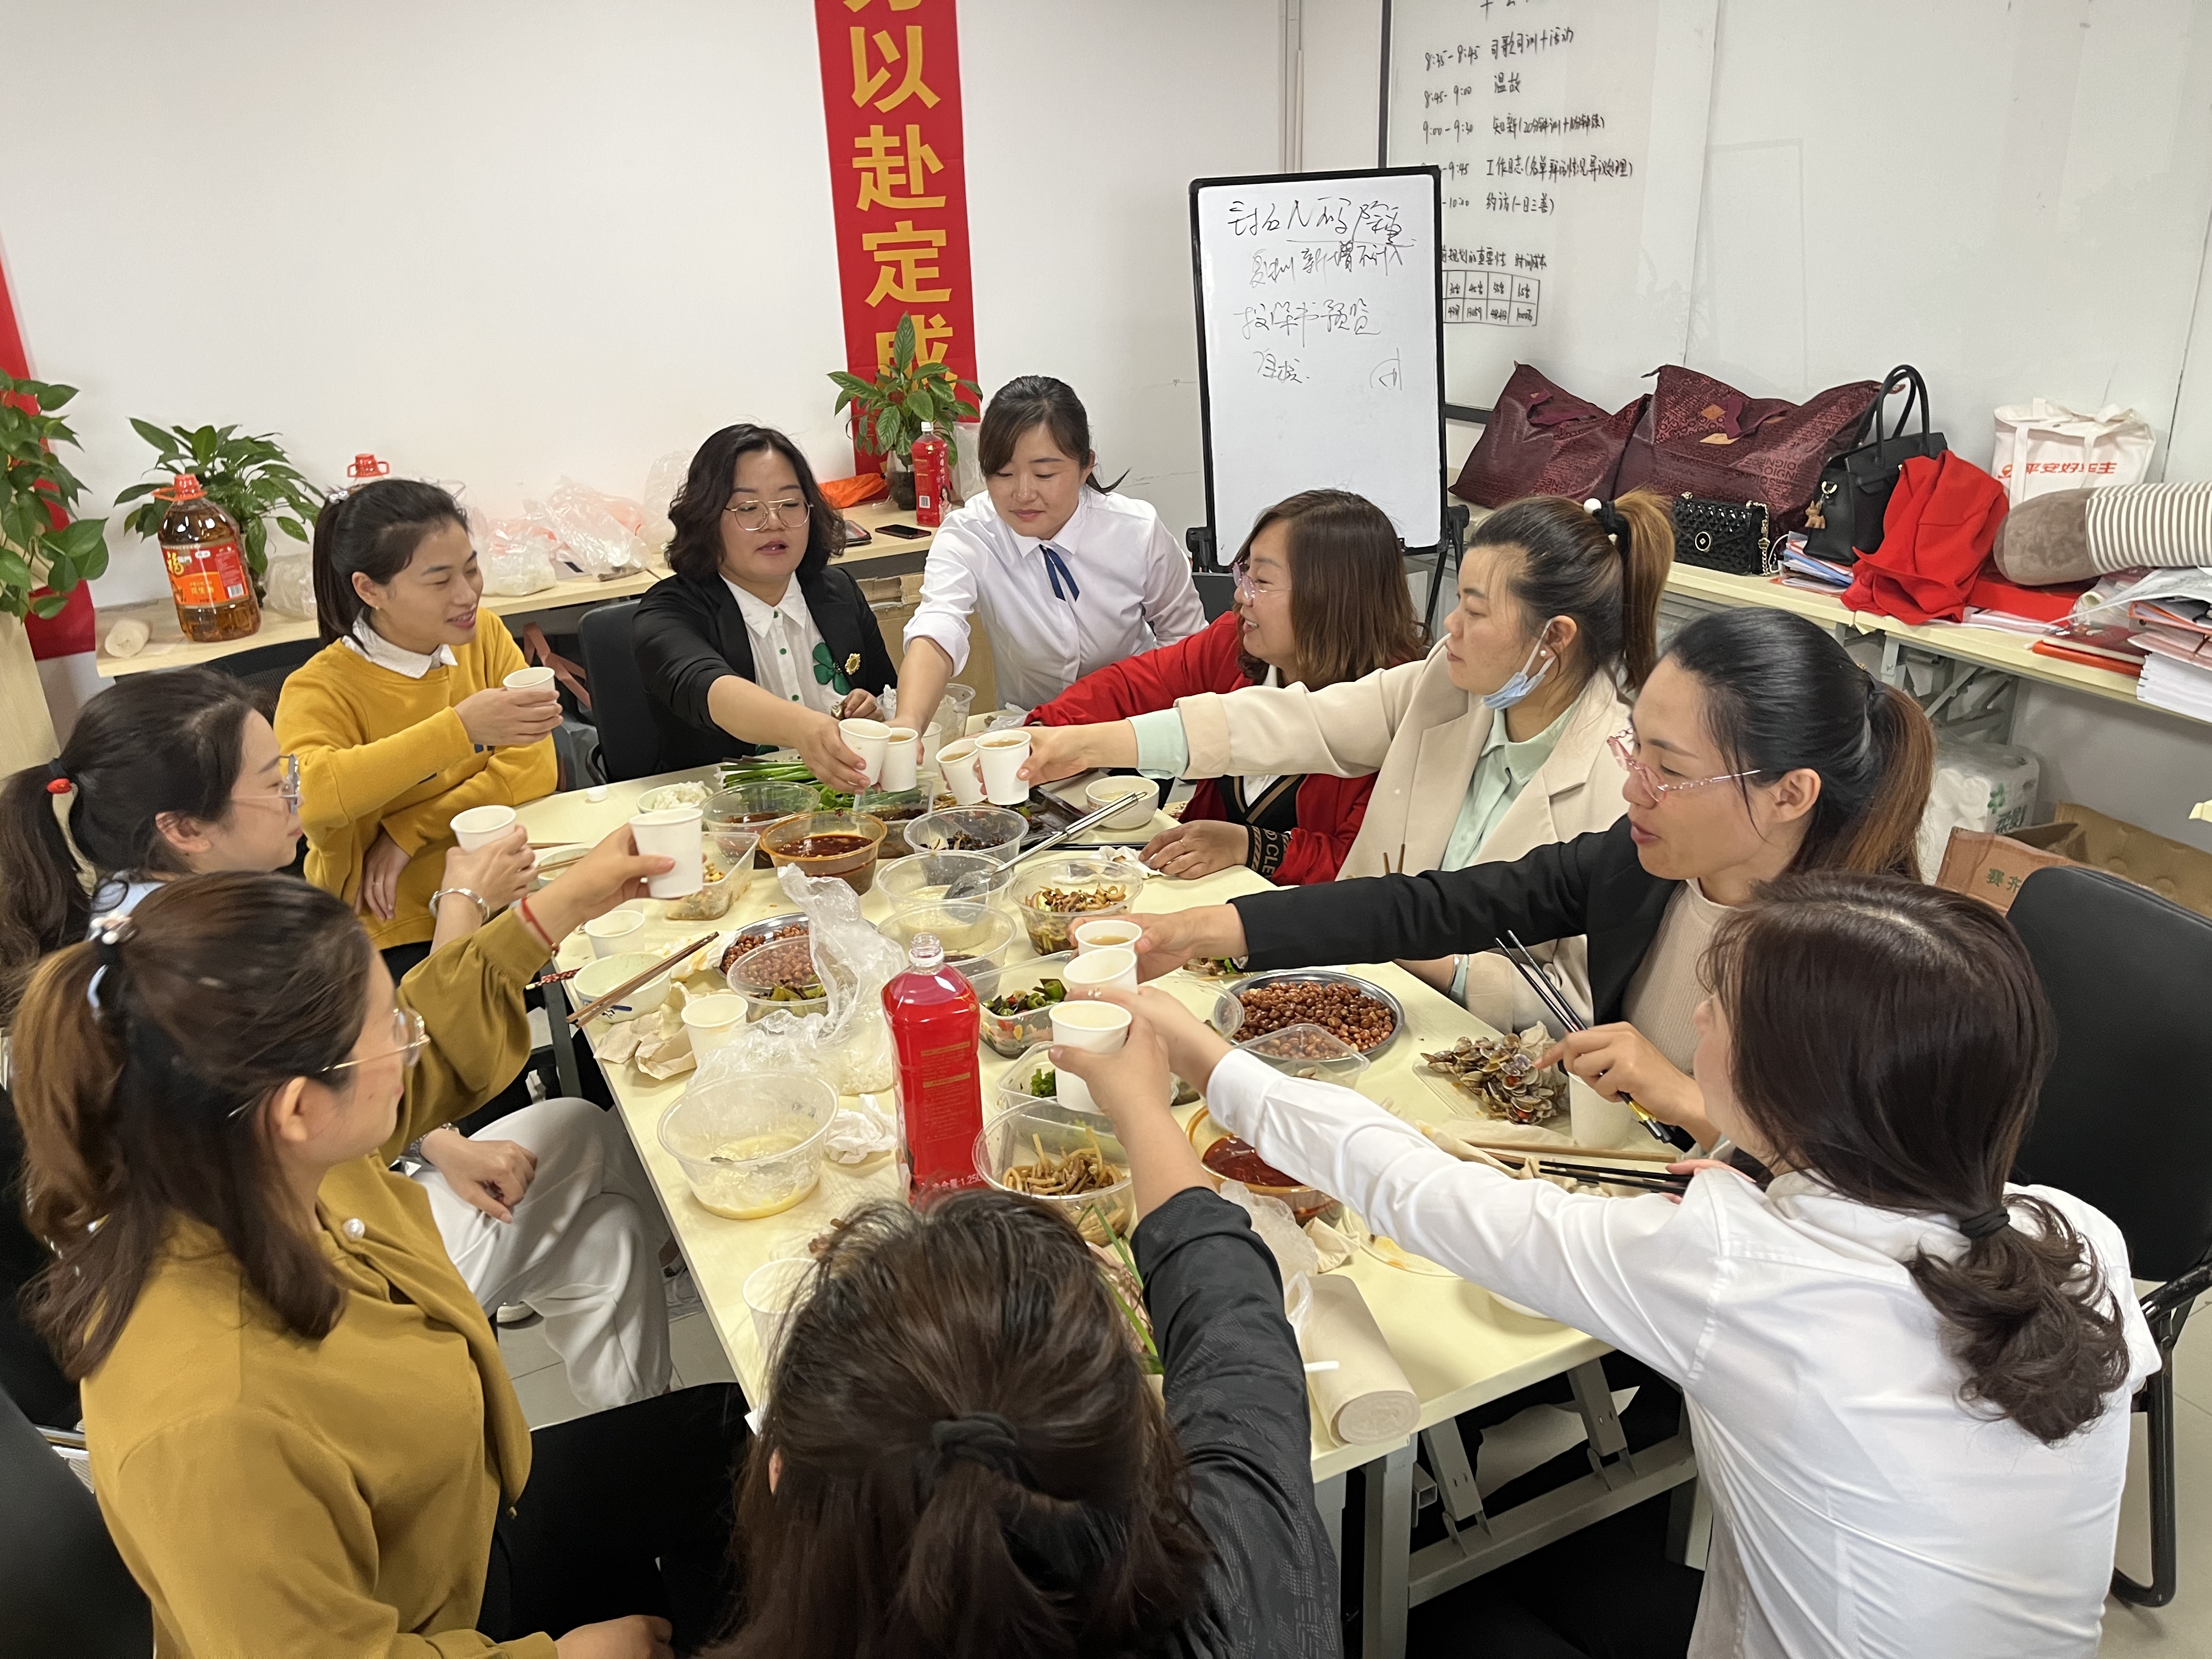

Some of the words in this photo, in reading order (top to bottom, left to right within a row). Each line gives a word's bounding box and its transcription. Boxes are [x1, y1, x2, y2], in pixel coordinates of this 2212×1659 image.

[1494, 72, 1521, 93] 温故
[843, 0, 958, 392] 以赴定成
